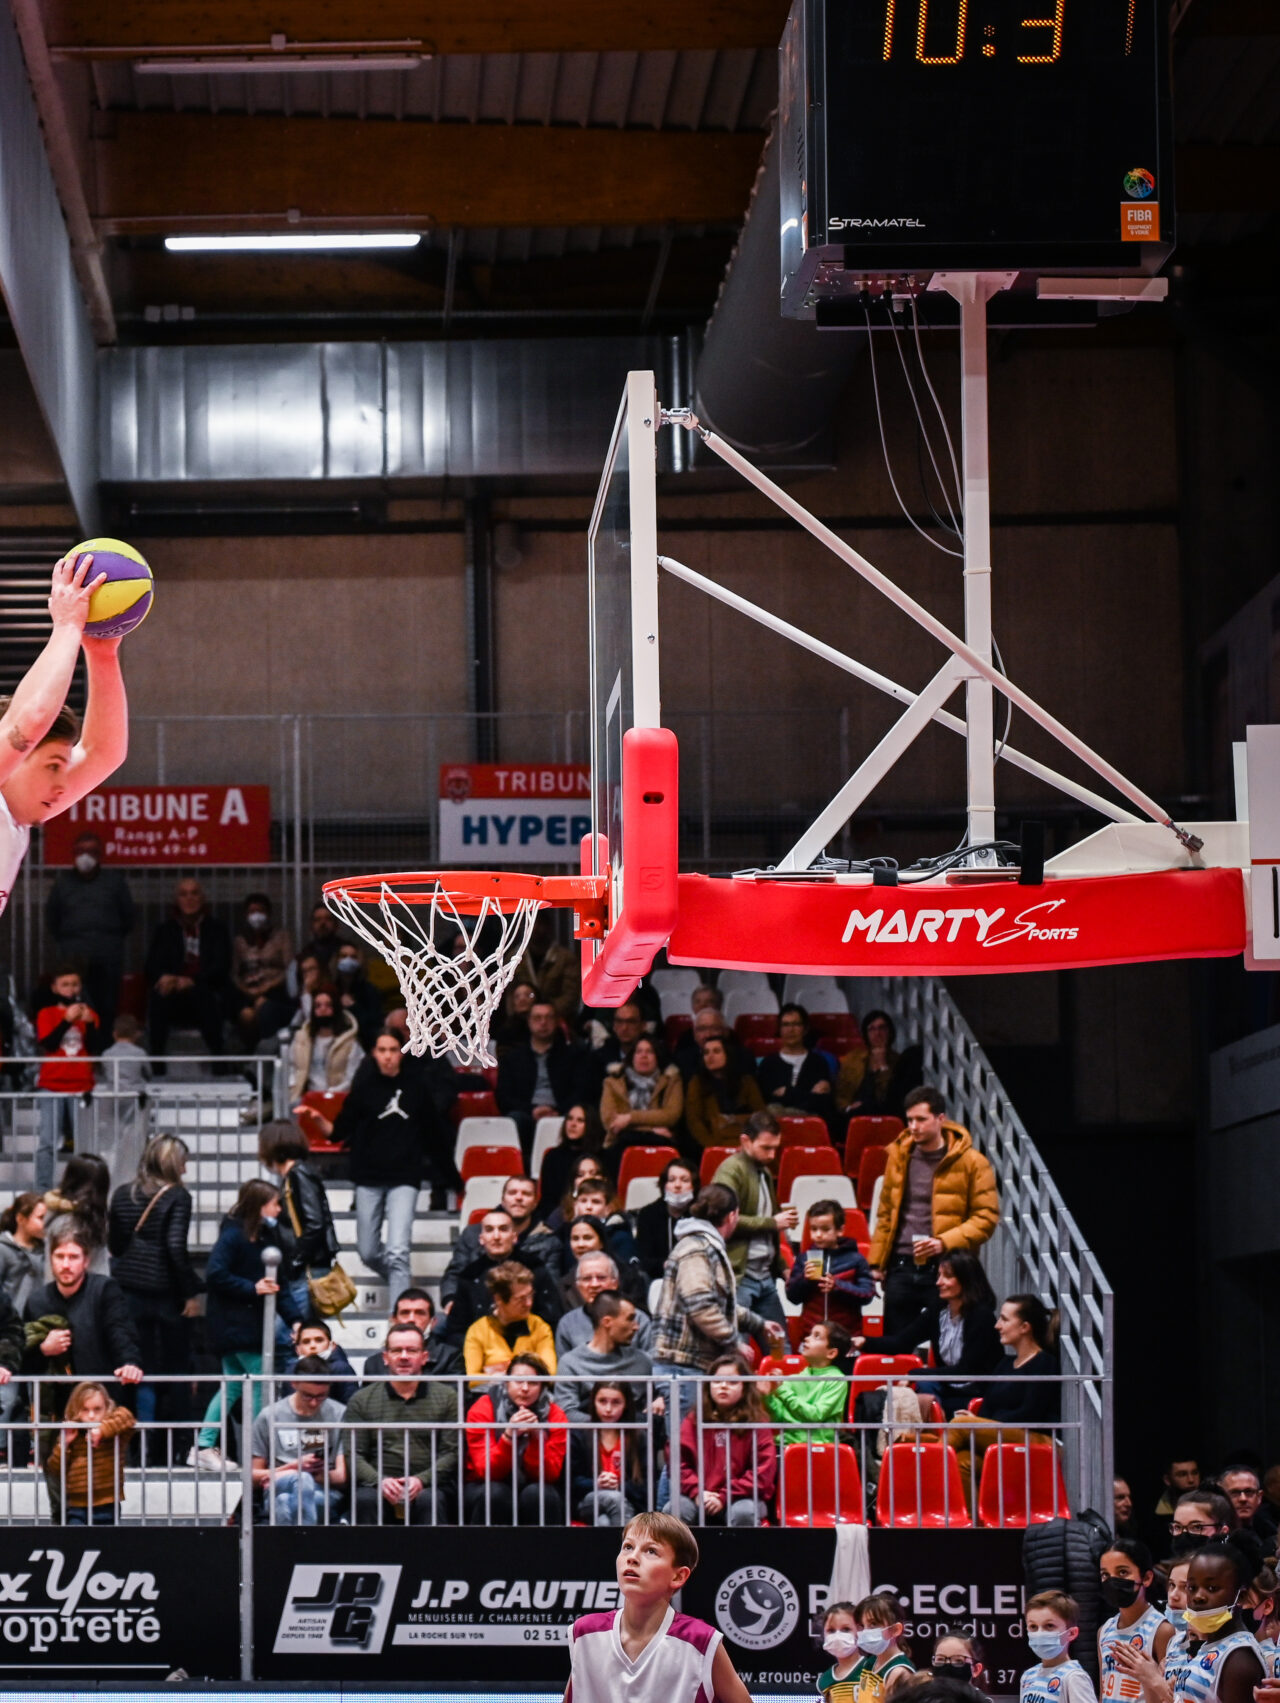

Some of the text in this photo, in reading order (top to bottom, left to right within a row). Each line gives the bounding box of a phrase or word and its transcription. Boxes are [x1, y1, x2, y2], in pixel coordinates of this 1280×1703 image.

[1127, 209, 1153, 221] FIBA
[828, 217, 926, 230] STRAMATEL
[495, 770, 592, 793] TRIBUN
[219, 788, 249, 826] A
[841, 907, 1006, 943] MARTY
[365, 1292, 377, 1303] H
[366, 1327, 376, 1338] G
[411, 1580, 470, 1609] J.P
[408, 1613, 473, 1622] MENUISERIE
[488, 1613, 552, 1622] CHARPENTE
[523, 1629, 539, 1641] 02
[544, 1629, 560, 1641] 51
[997, 1670, 1015, 1684] 37
